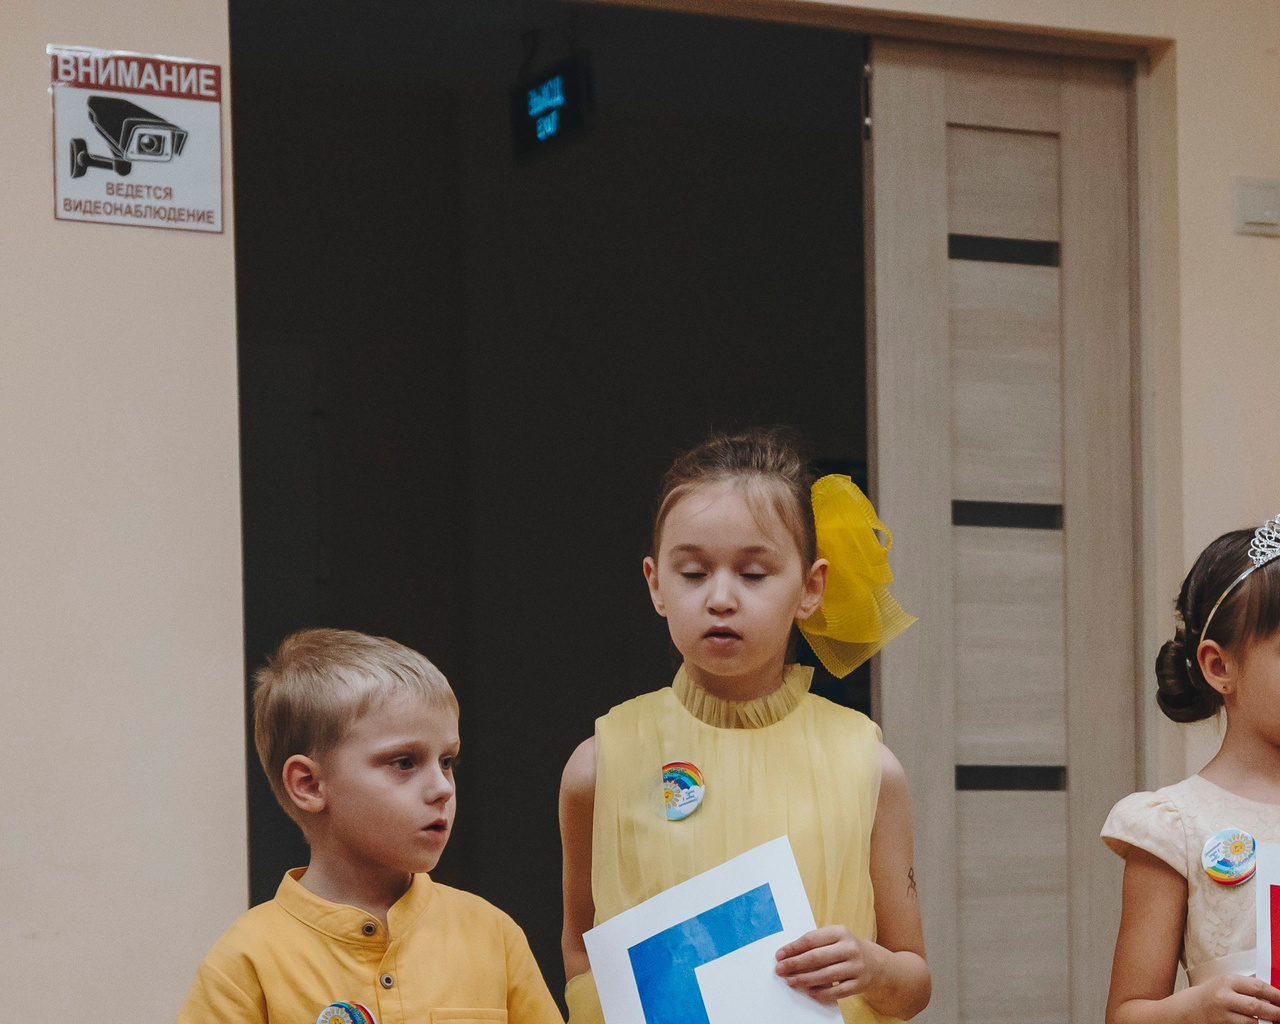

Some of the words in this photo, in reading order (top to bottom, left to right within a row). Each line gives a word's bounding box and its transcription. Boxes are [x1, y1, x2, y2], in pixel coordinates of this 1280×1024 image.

[57, 55, 216, 97] ВНИМАНИЕ
[106, 182, 173, 200] ВЕДЕТСЯ
[63, 198, 215, 224] ВИДЕОНАБЛЮДЕНИЕ
